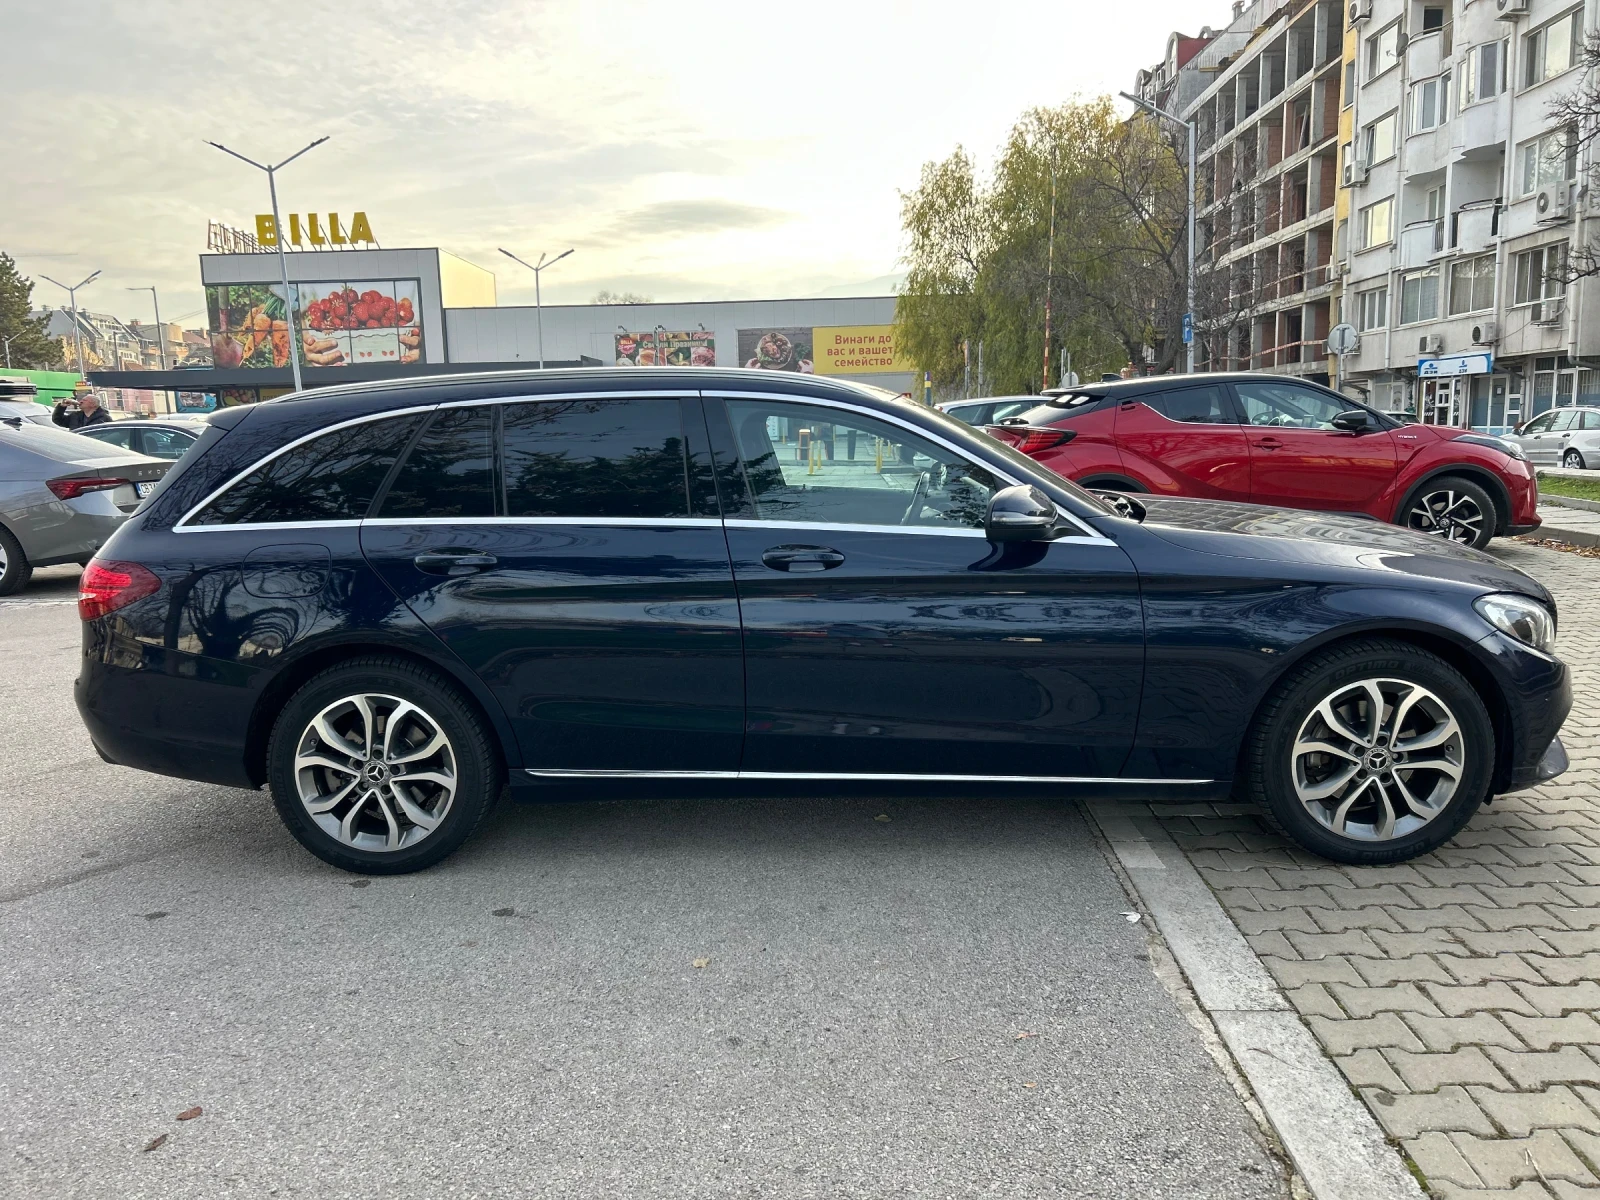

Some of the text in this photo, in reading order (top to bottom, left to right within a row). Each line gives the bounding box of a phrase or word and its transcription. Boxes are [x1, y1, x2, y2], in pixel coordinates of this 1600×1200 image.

[255, 212, 375, 246] BILLA
[835, 335, 892, 344] Винаги до
[827, 348, 845, 356] вас
[834, 357, 893, 367] семейство
